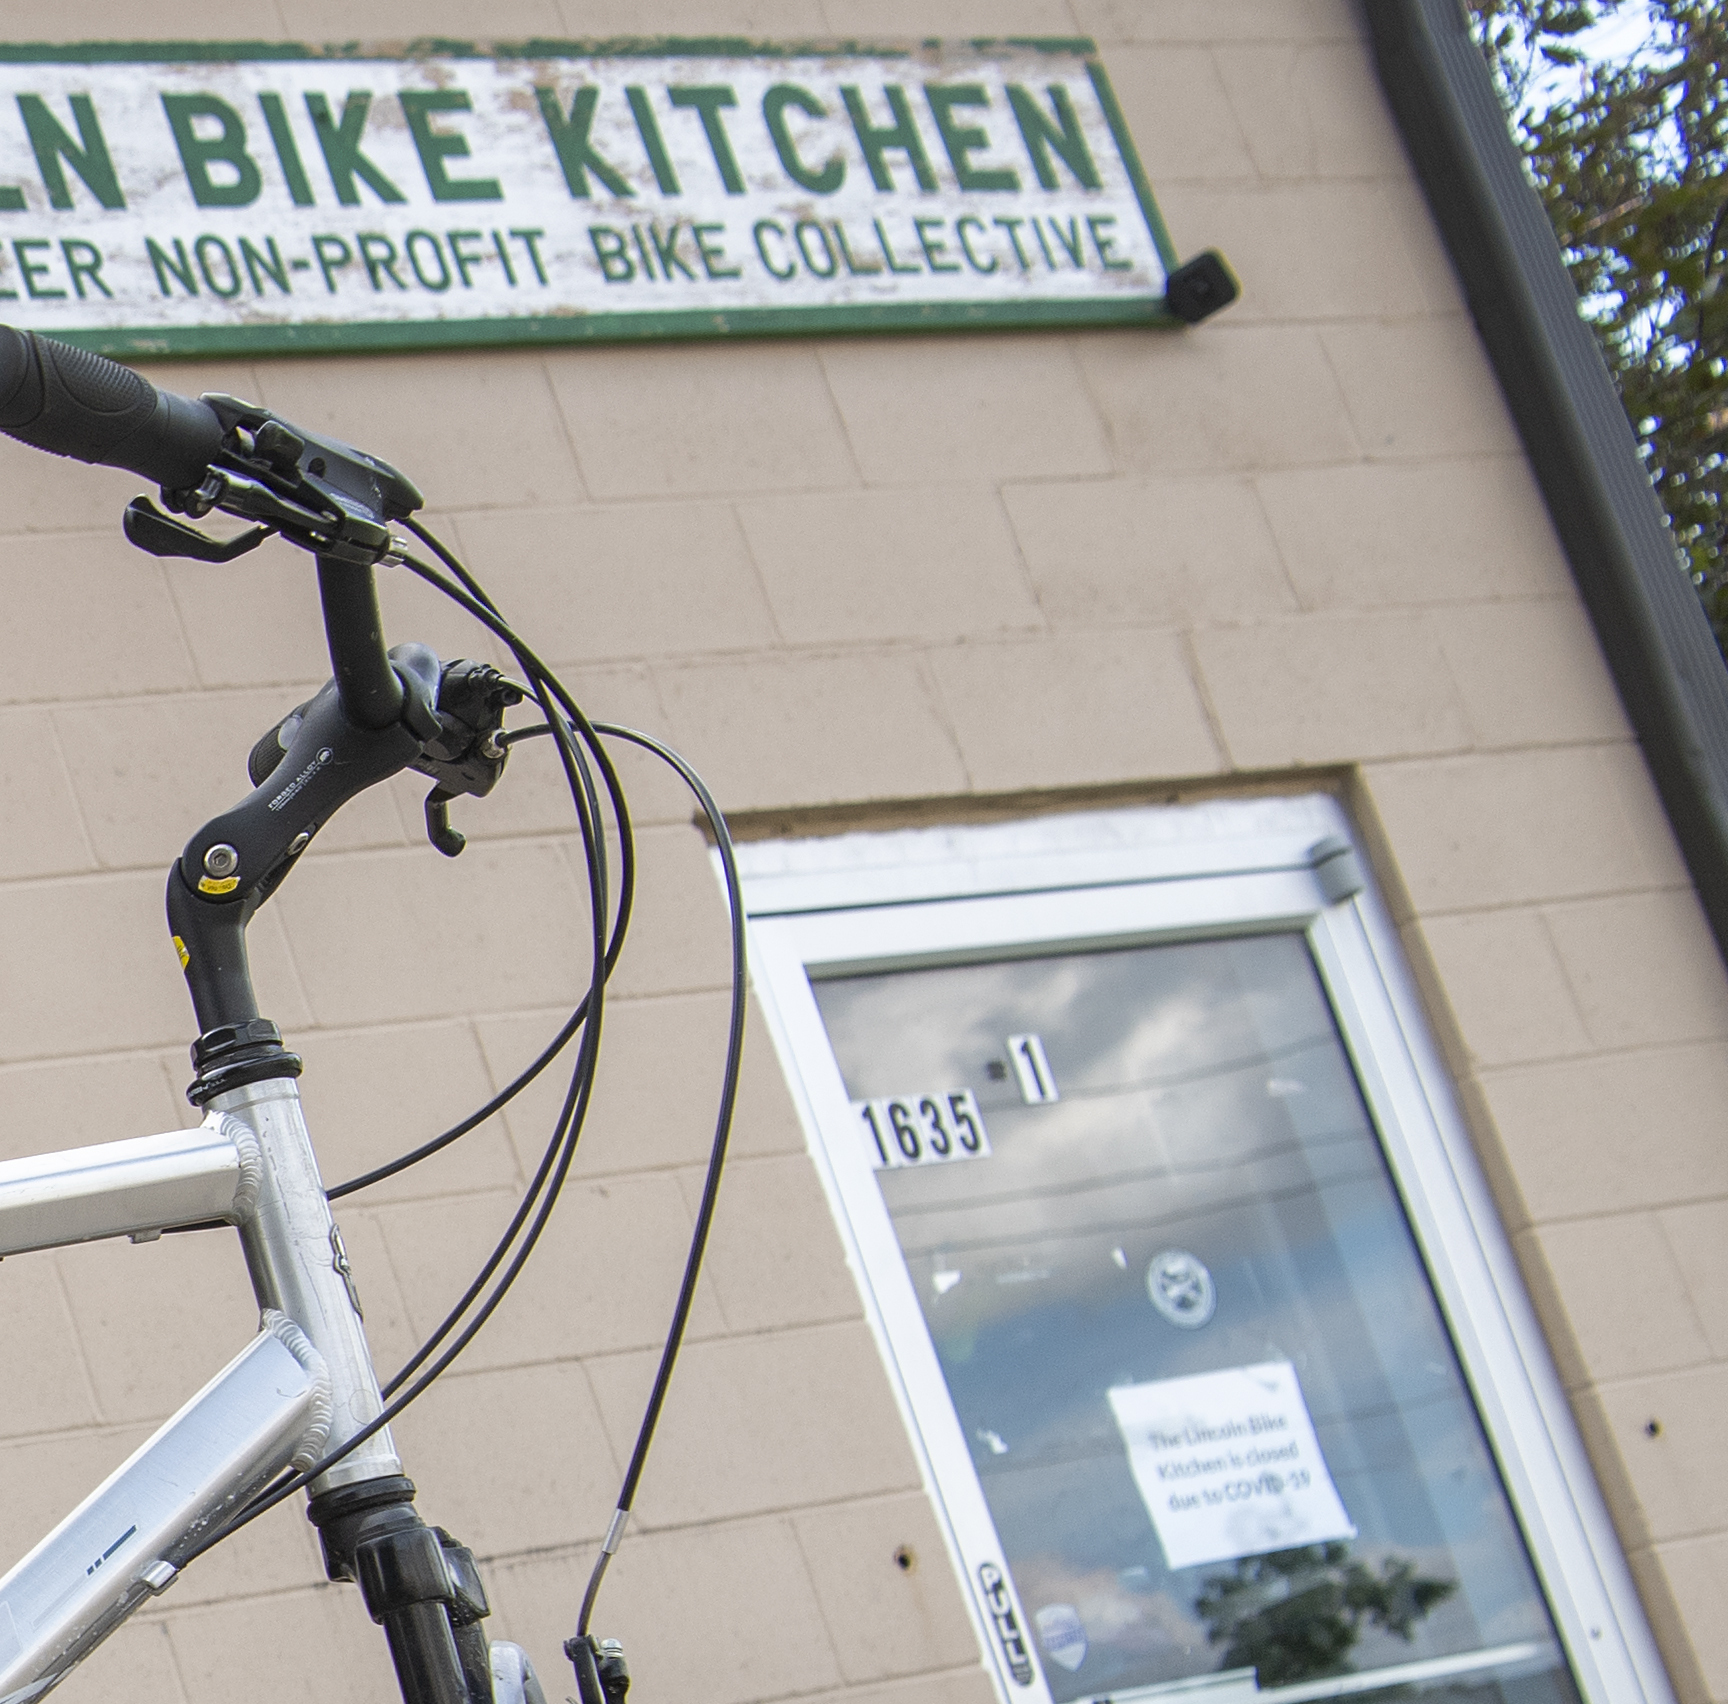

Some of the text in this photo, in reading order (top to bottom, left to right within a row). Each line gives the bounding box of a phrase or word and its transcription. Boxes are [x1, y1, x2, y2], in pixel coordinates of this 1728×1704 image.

[160, 88, 505, 209] BIKE
[534, 82, 1104, 199] KITCHEN
[144, 226, 552, 299] NON-PROFIT
[588, 223, 742, 284] BIKE
[752, 214, 1135, 281] COLLECTIVE
[1021, 1040, 1048, 1099] 1
[862, 1093, 982, 1166] 1635
[1157, 1452, 1228, 1481] Kitchen
[1246, 1440, 1300, 1466] closed
